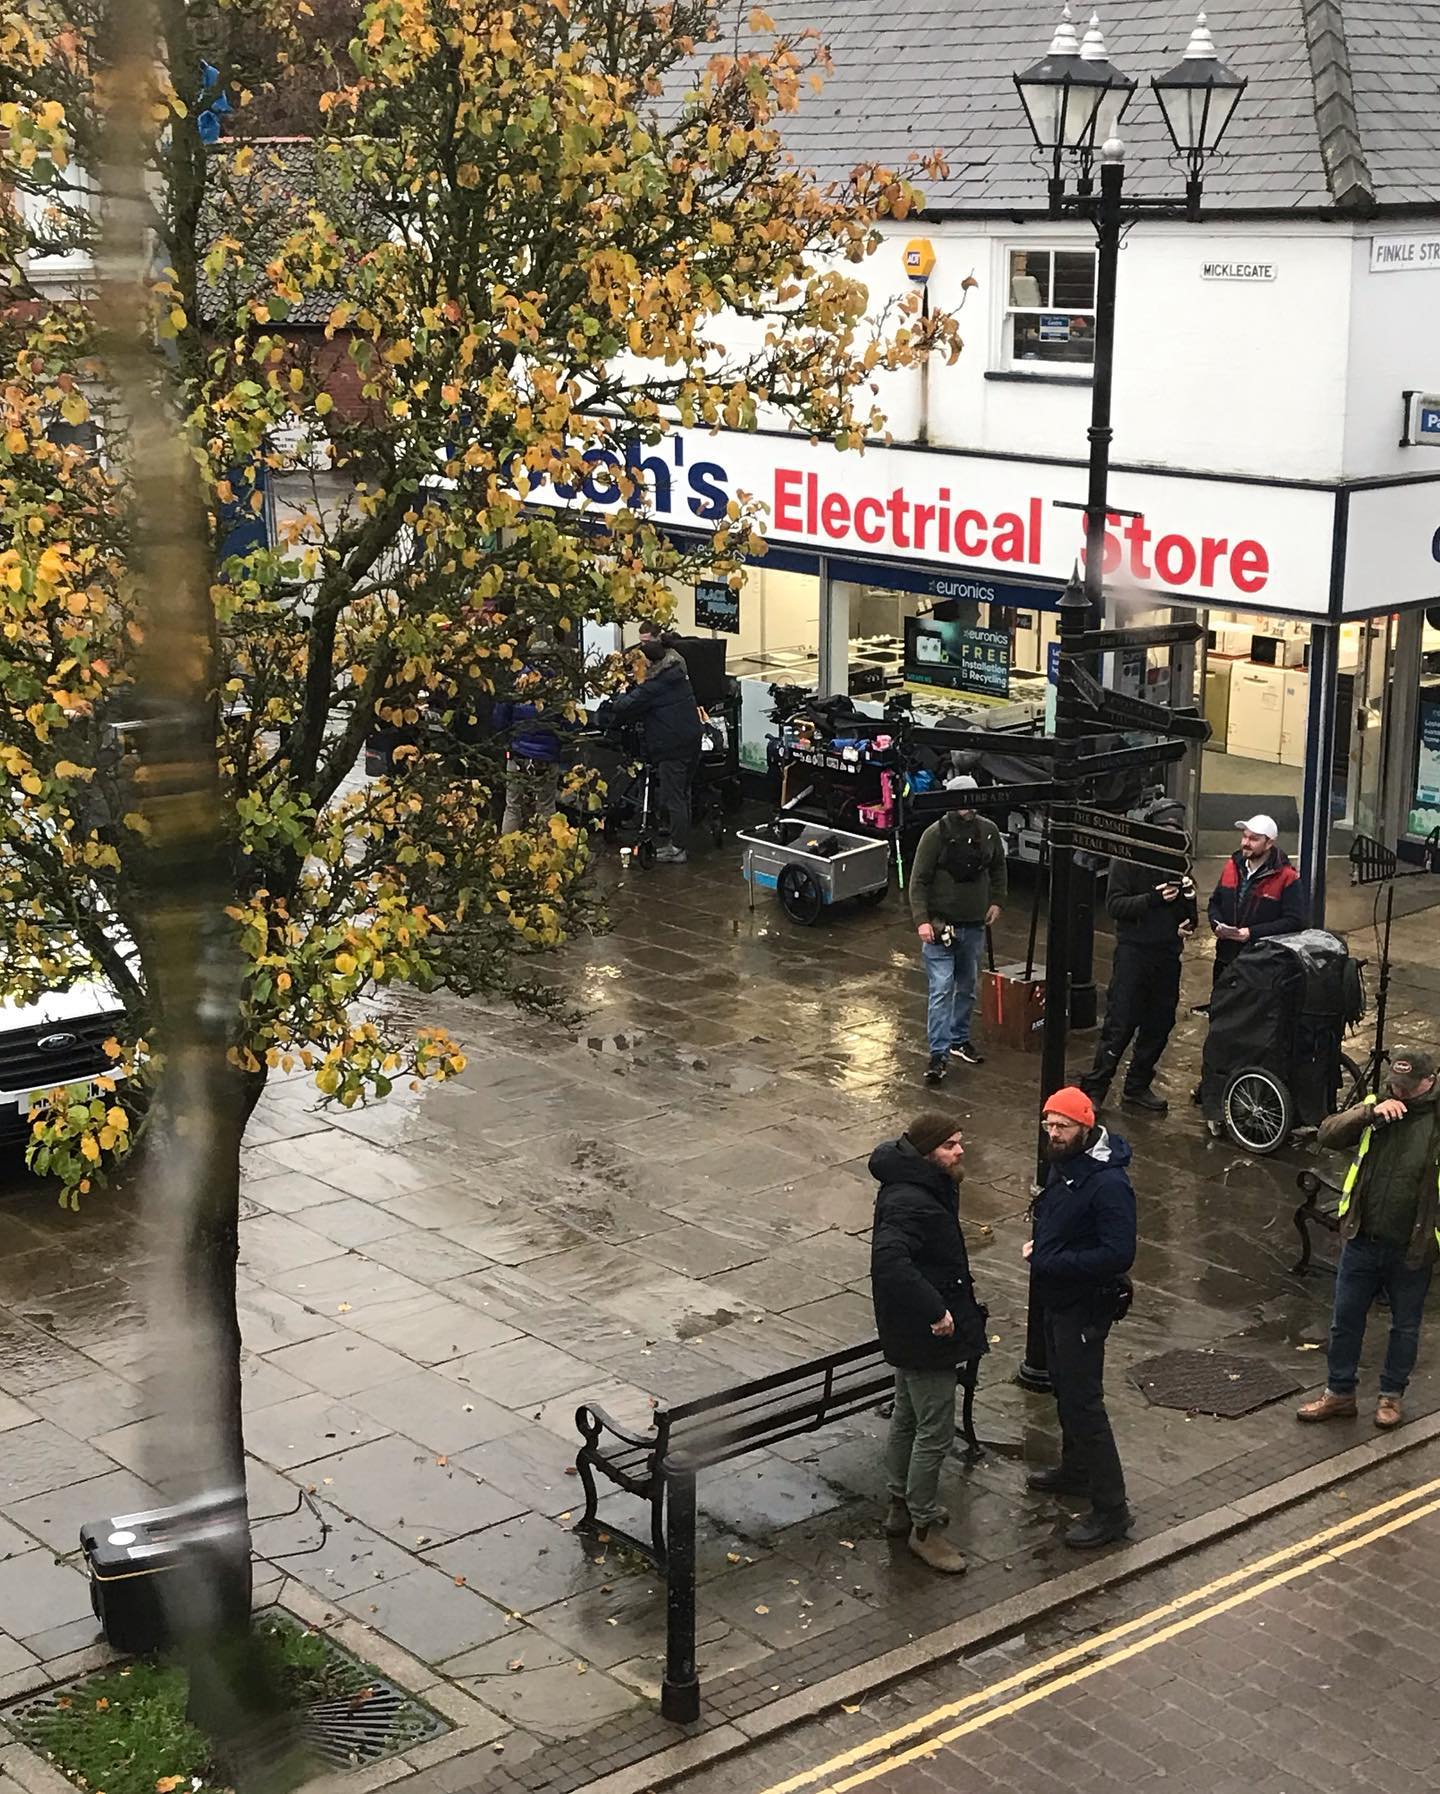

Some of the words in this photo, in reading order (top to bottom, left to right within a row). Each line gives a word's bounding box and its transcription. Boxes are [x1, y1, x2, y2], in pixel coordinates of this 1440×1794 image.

[1376, 244, 1415, 262] FINKLE
[1203, 264, 1272, 278] MICKLEGATE
[774, 467, 1042, 565] Electrical
[1080, 510, 1270, 594] Store
[936, 580, 995, 602] euronics
[969, 630, 1008, 645] euronics
[962, 644, 1008, 664] FREE
[962, 658, 1007, 675] Installation
[969, 670, 1007, 688] Recycling
[963, 791, 1013, 805] LIBRARY
[1074, 811, 1091, 824] THE
[1093, 815, 1131, 835] SUMMIT
[1072, 832, 1105, 850] RETAIL
[1107, 841, 1133, 858] PARK
